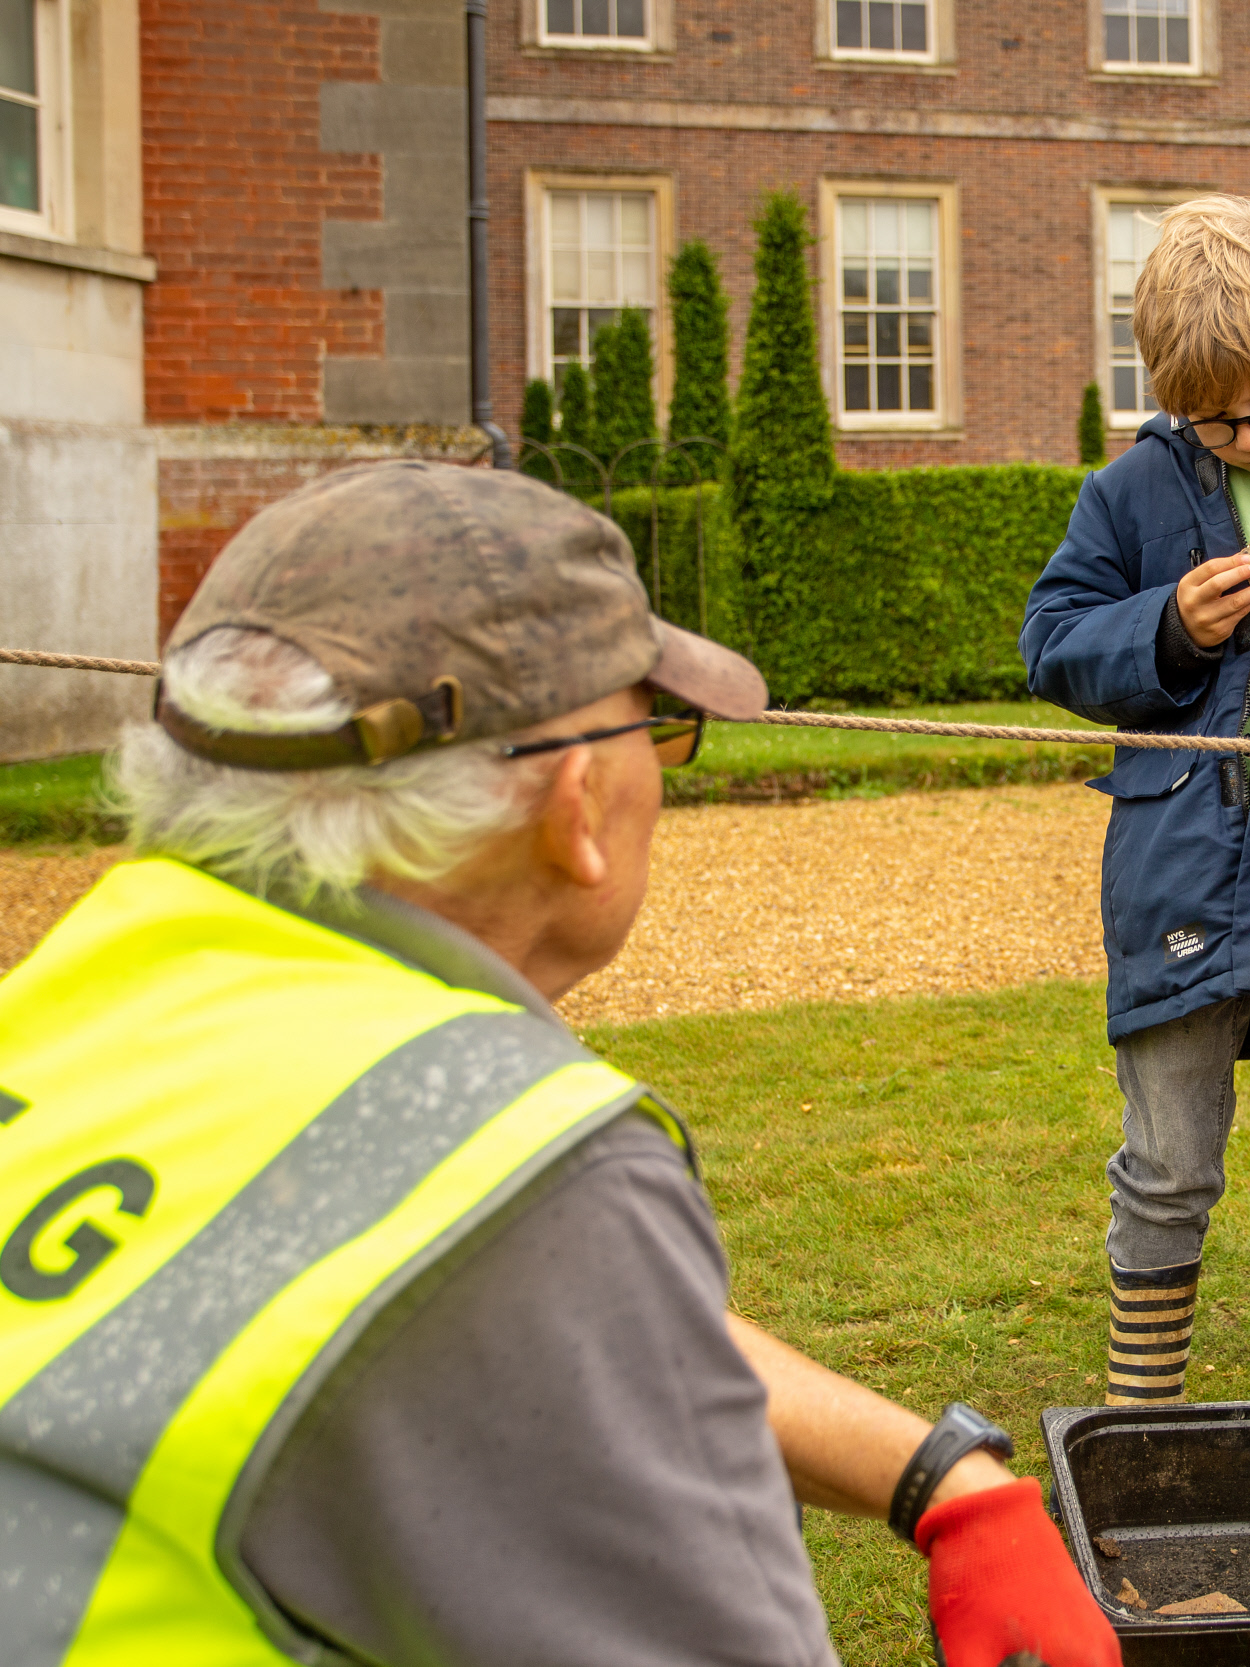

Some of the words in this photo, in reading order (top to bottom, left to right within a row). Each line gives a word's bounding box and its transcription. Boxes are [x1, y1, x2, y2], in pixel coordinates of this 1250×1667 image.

[1167, 930, 1184, 941] NYC
[1177, 943, 1203, 957] URBAN
[0, 1087, 155, 1300] G
